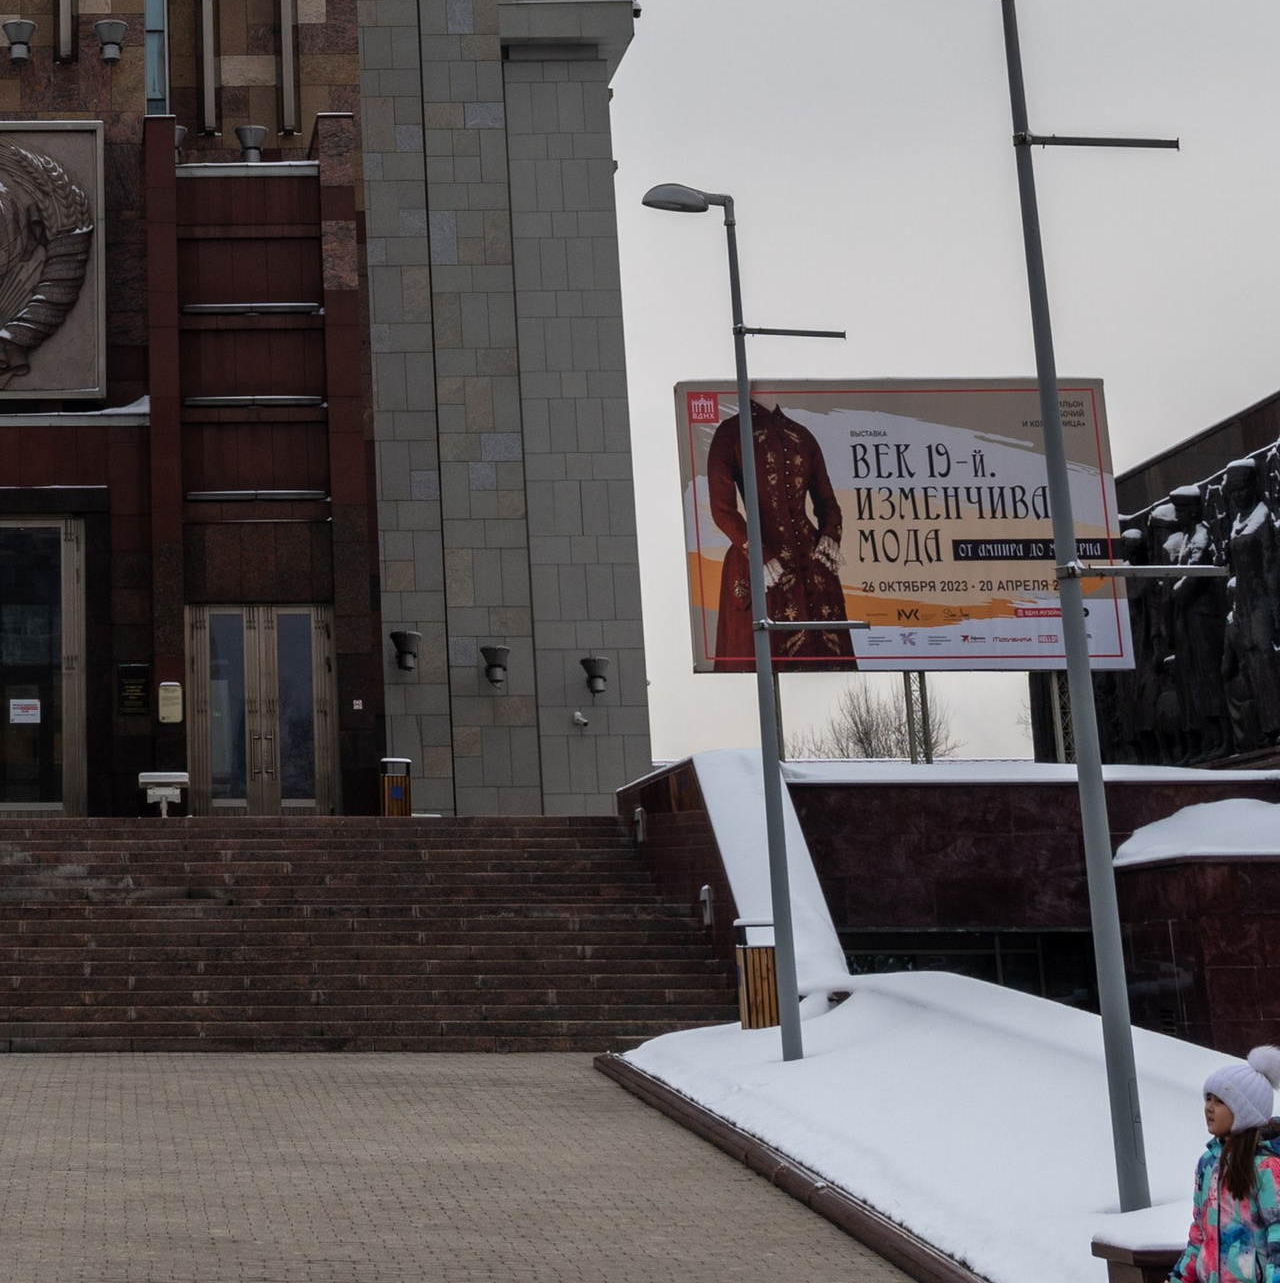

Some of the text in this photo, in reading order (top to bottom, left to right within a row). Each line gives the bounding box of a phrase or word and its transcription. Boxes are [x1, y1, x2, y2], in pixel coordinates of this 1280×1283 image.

[850, 443, 915, 478] ВЕК
[858, 529, 943, 566] МОДА
[959, 544, 973, 556] ОТ
[1029, 543, 1044, 556] ДО
[862, 582, 875, 592] 26
[879, 581, 936, 592] ОКТЯБРЯ
[940, 581, 968, 591] 2023
[979, 581, 993, 591] 20
[997, 580, 1049, 591] АПРЕЛЯ
